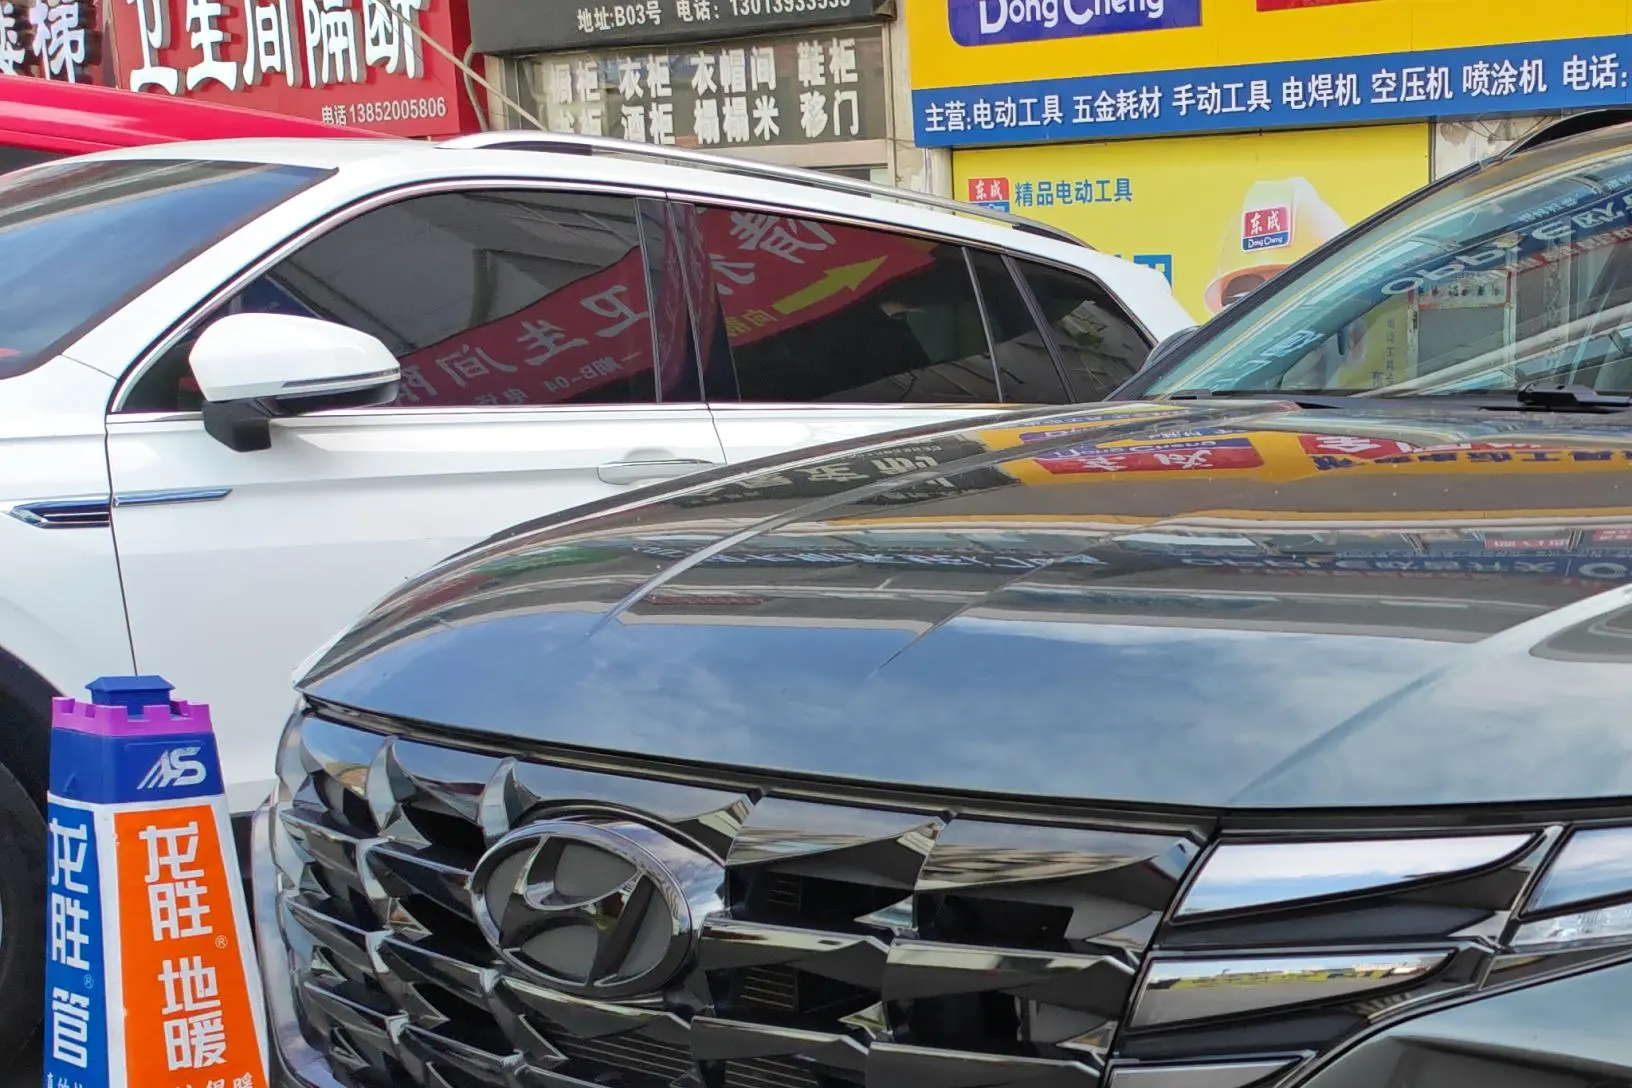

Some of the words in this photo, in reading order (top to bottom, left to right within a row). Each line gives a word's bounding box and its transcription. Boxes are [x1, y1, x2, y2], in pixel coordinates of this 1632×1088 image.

[980, 0, 1059, 34] Dong
[129, 0, 425, 93] 卫生间隔断
[690, 47, 776, 96] 衣帽间
[797, 37, 858, 87] 鞋柜
[349, 97, 447, 124] 13852005806
[621, 102, 676, 145] 酒柜
[693, 95, 780, 145] 榻榻米
[800, 90, 860, 138] 移门
[1072, 88, 1162, 123] 五金耗材
[1172, 81, 1272, 118] 手动工具
[1281, 74, 1361, 110] 电焊机
[1371, 67, 1452, 103] 空压机
[1462, 60, 1547, 97] 喷涂机
[1014, 177, 1133, 207] 精品电动工具
